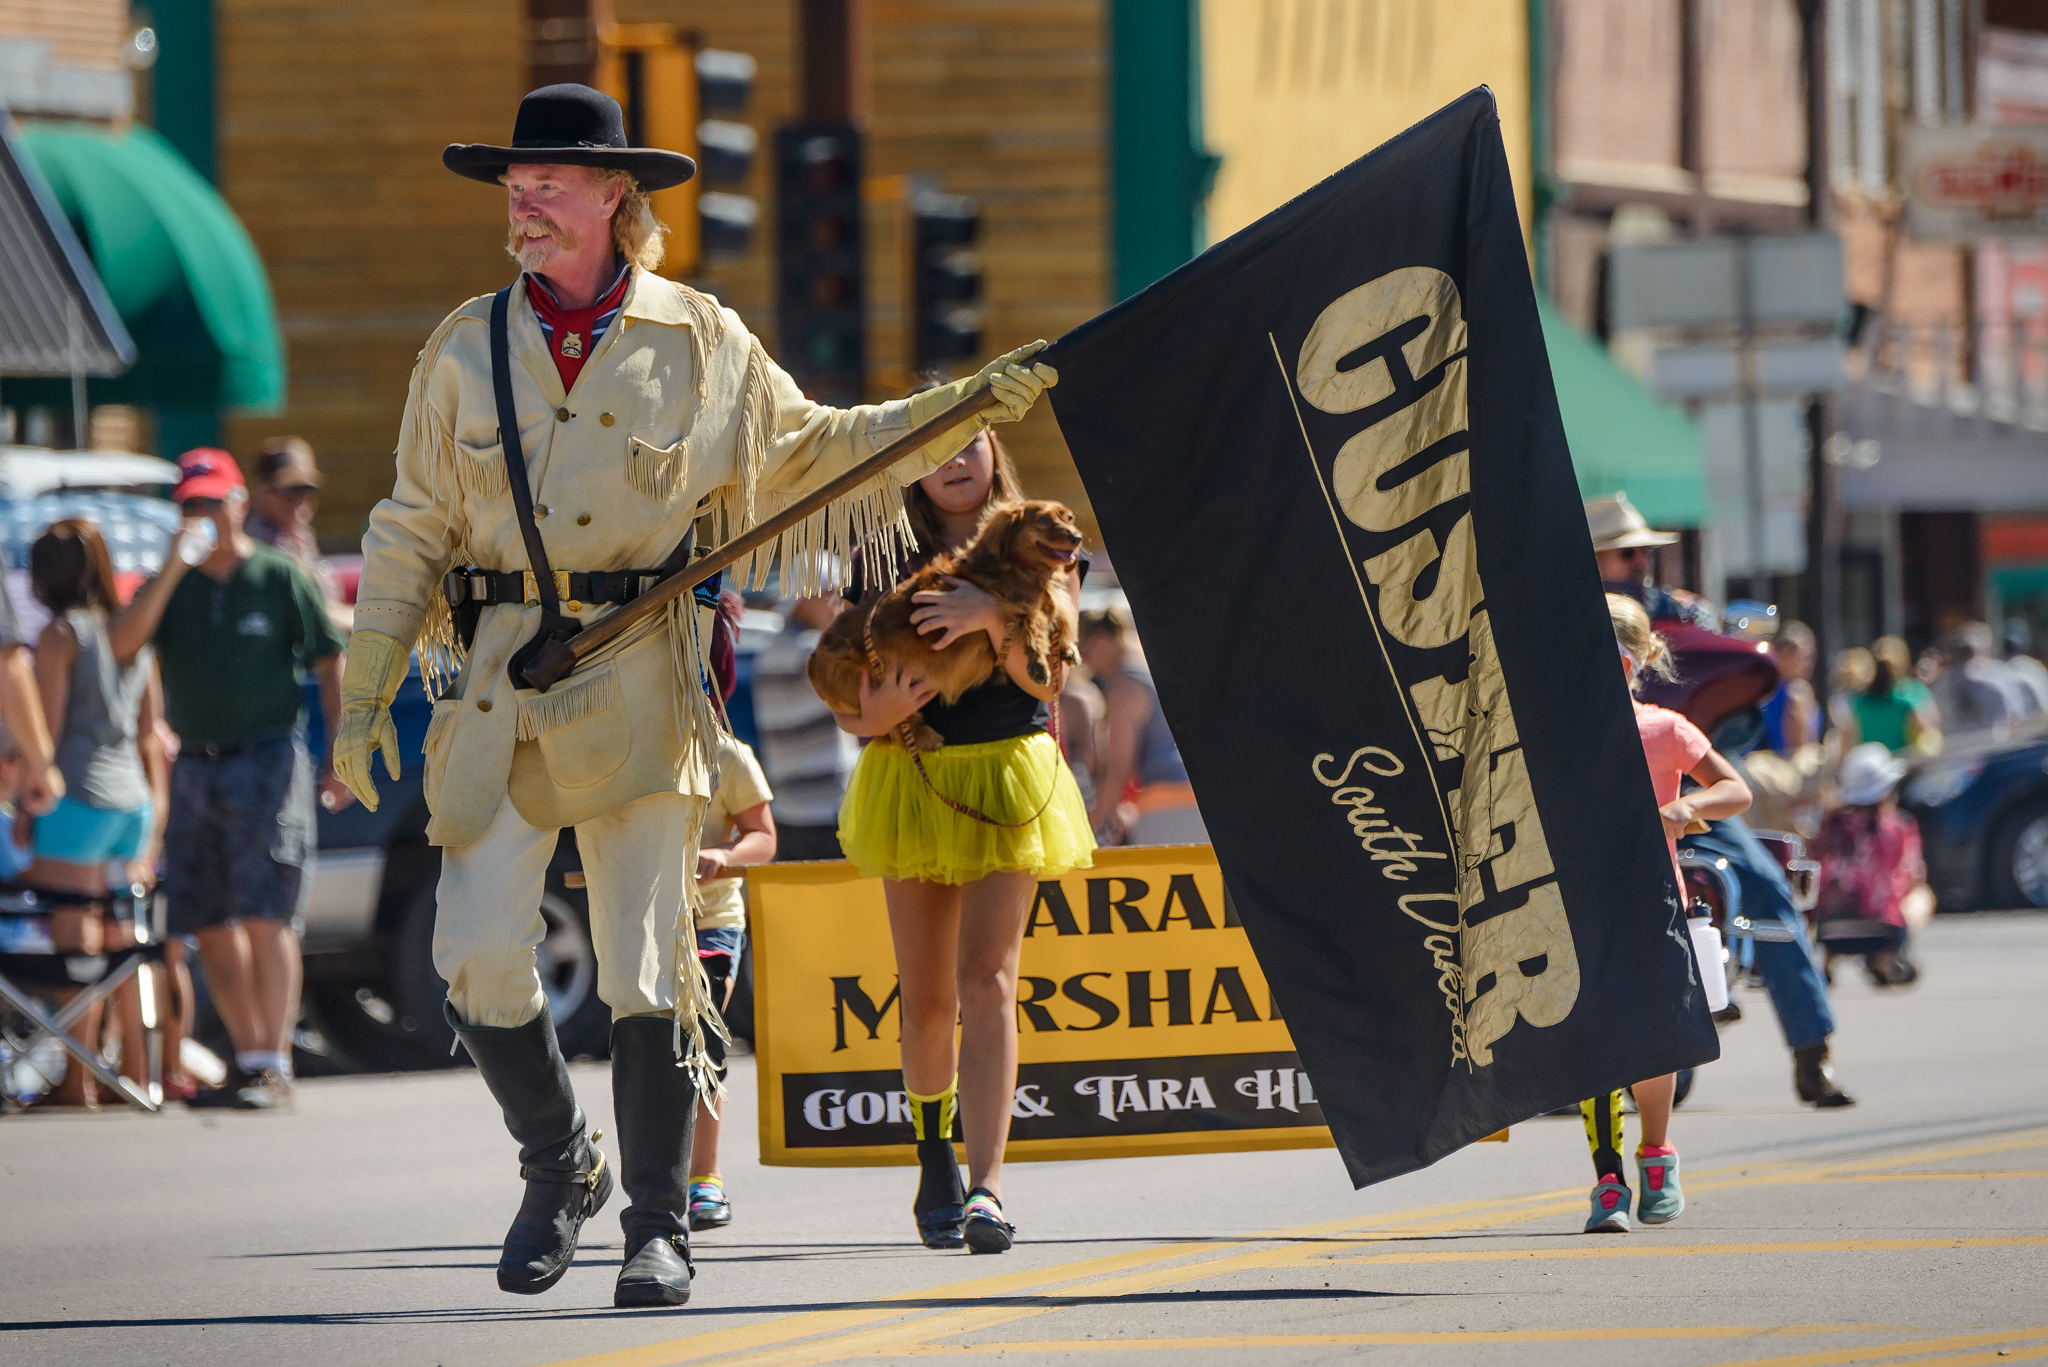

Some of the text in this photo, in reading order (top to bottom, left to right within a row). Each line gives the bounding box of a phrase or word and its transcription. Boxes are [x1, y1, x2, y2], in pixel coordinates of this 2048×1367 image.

[1312, 745, 1448, 881] South
[1023, 873, 1244, 938] ARA
[829, 966, 1281, 1052] MRSHA
[803, 1088, 959, 1131] GOR
[1011, 1084, 1055, 1119] &
[1073, 1073, 1217, 1122] TARA
